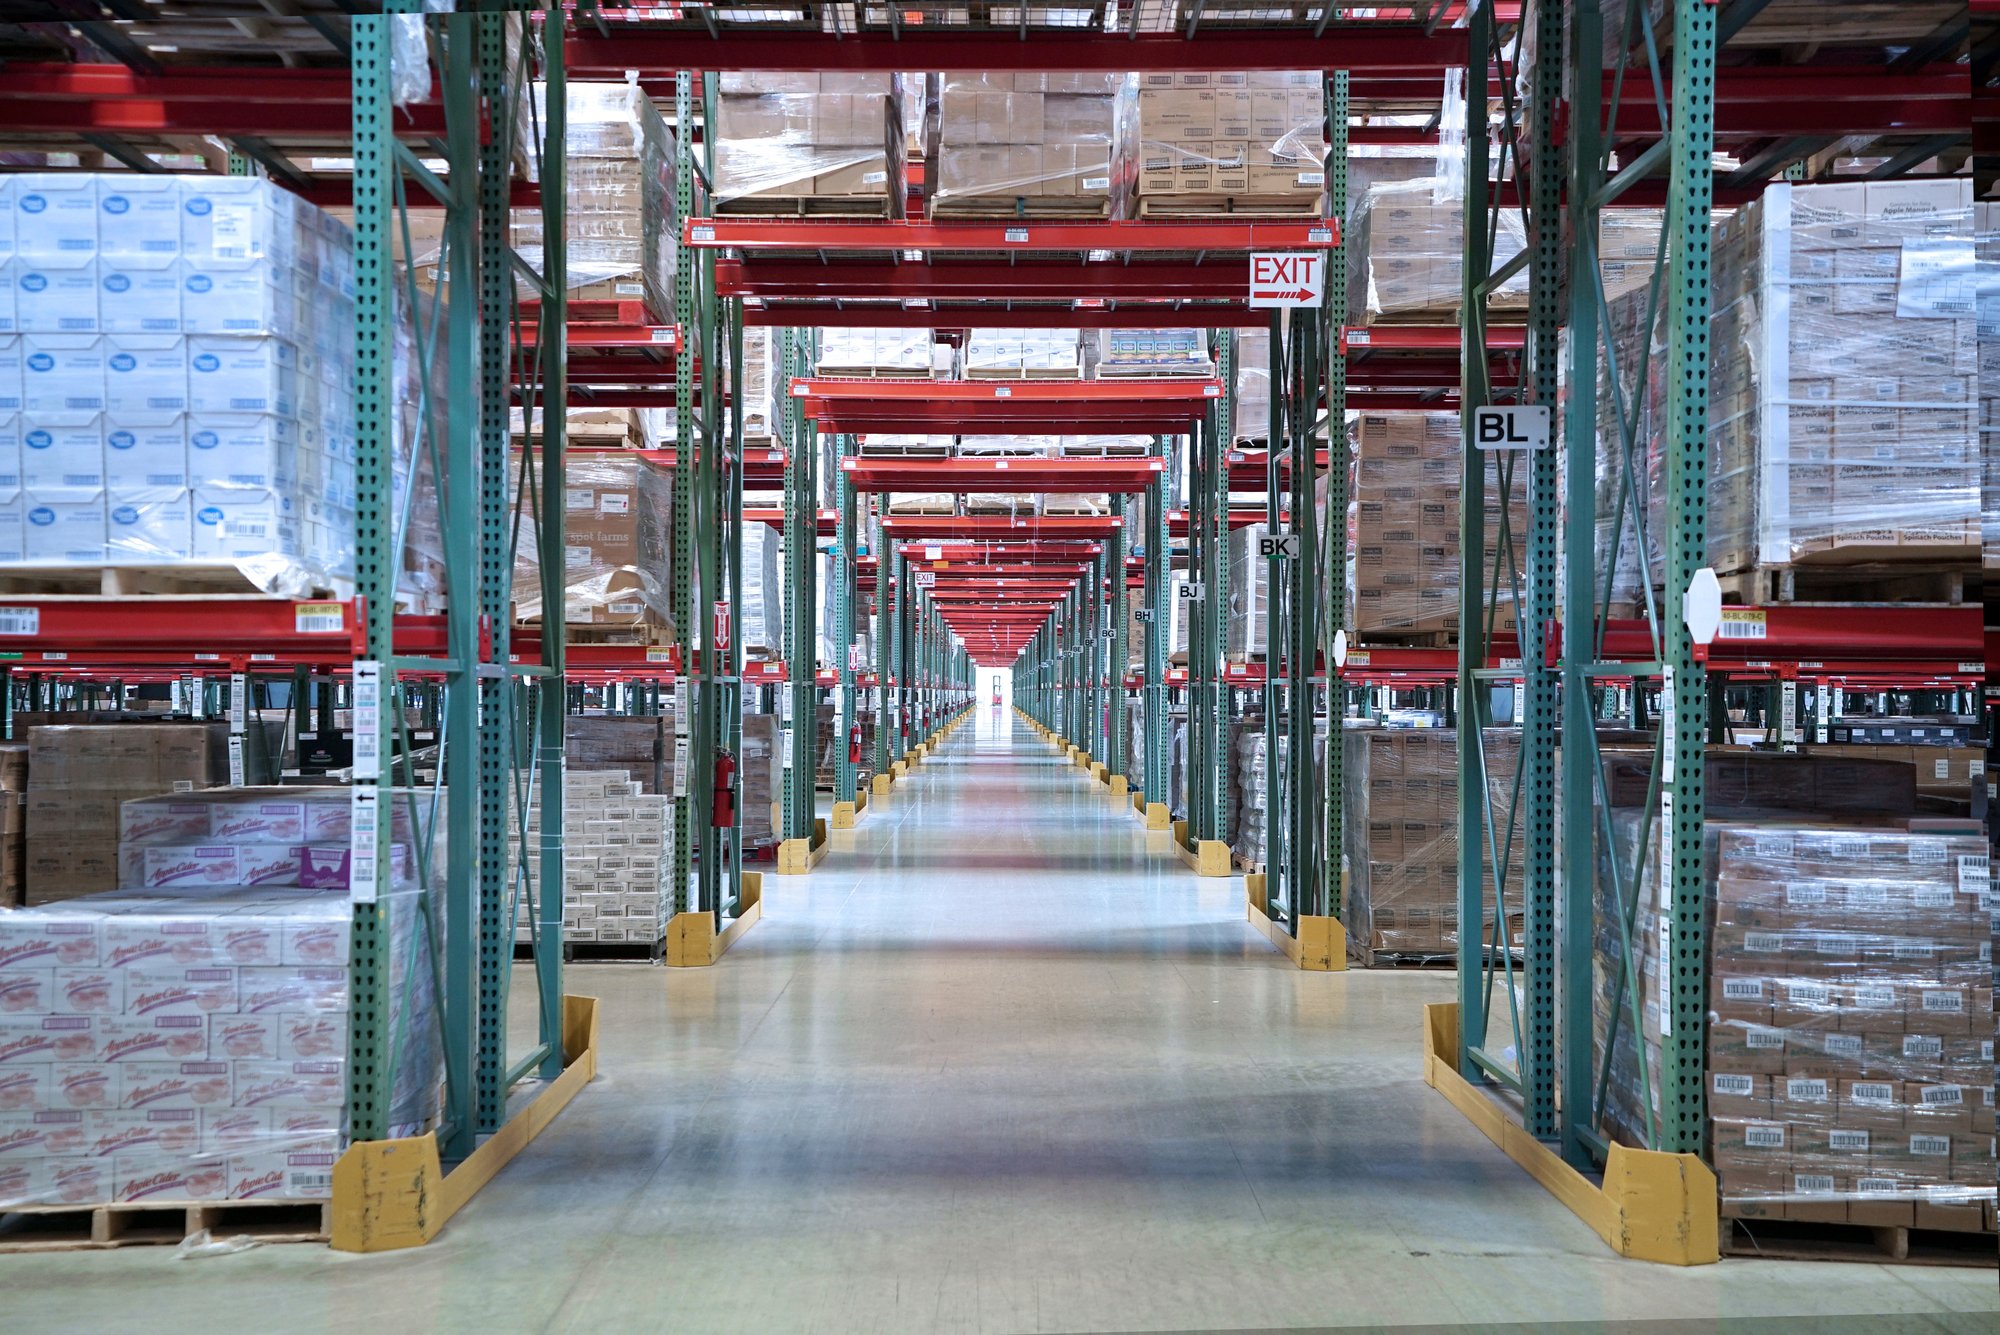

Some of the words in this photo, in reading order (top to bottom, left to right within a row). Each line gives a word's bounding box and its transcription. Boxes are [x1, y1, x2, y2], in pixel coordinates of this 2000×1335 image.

[1905, 206, 1930, 214] Mango
[1254, 257, 1317, 284] EXIT
[1479, 413, 1529, 442] BL
[570, 531, 594, 544] spot
[597, 531, 629, 541] farms
[1260, 538, 1290, 556] BK
[916, 573, 934, 581] EXIT
[1180, 586, 1198, 598] BJ
[1135, 611, 1150, 620] BH
[1722, 612, 1763, 620] 40-BL-079-C
[1102, 629, 1115, 637] BG
[147, 867, 176, 882] Apple
[176, 862, 200, 873] Cider
[241, 867, 271, 882] Apple
[271, 861, 294, 872] Cider
[117, 1178, 151, 1198] Apple
[152, 1172, 181, 1186] Cider
[230, 1178, 264, 1196] Apple
